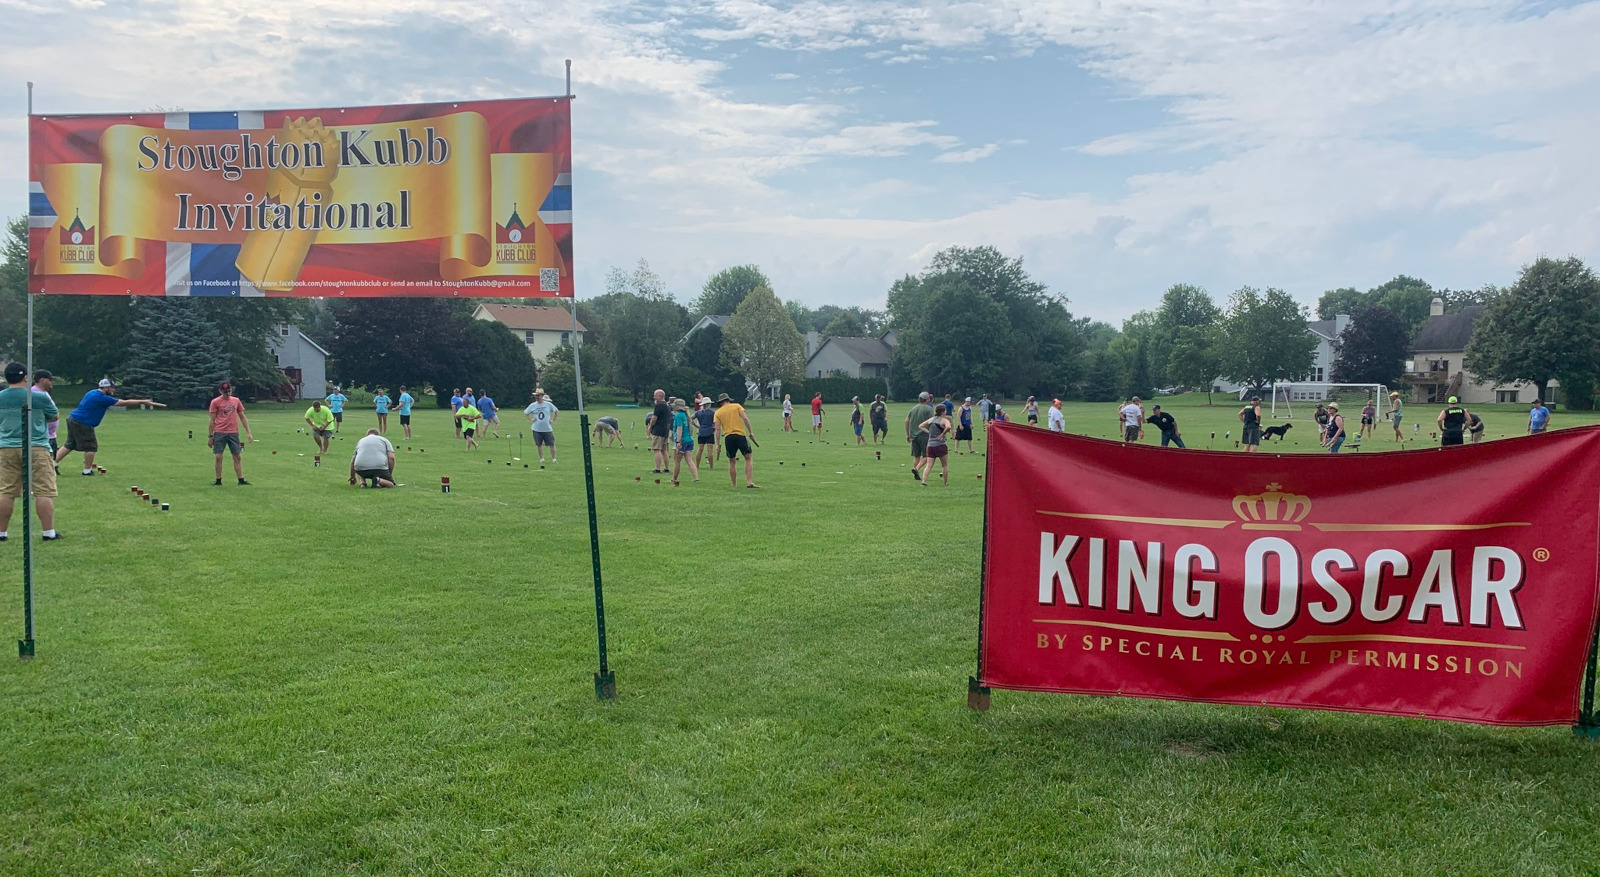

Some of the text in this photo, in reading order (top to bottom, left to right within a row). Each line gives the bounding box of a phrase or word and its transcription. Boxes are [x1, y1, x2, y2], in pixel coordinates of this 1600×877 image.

[137, 126, 450, 181] Stoughton Kubb
[173, 189, 413, 231] Invitational
[60, 249, 95, 261] KUBB CLUB
[496, 249, 536, 261] KUBB CLUB
[203, 279, 231, 287] Facebook
[442, 279, 531, 289] StoughtonKubb@gmail.com
[1038, 531, 1219, 620] KING
[1243, 537, 1526, 630] OSCAR
[1036, 633, 1523, 679] BY SPECIAL ROYAL PERMISSION
